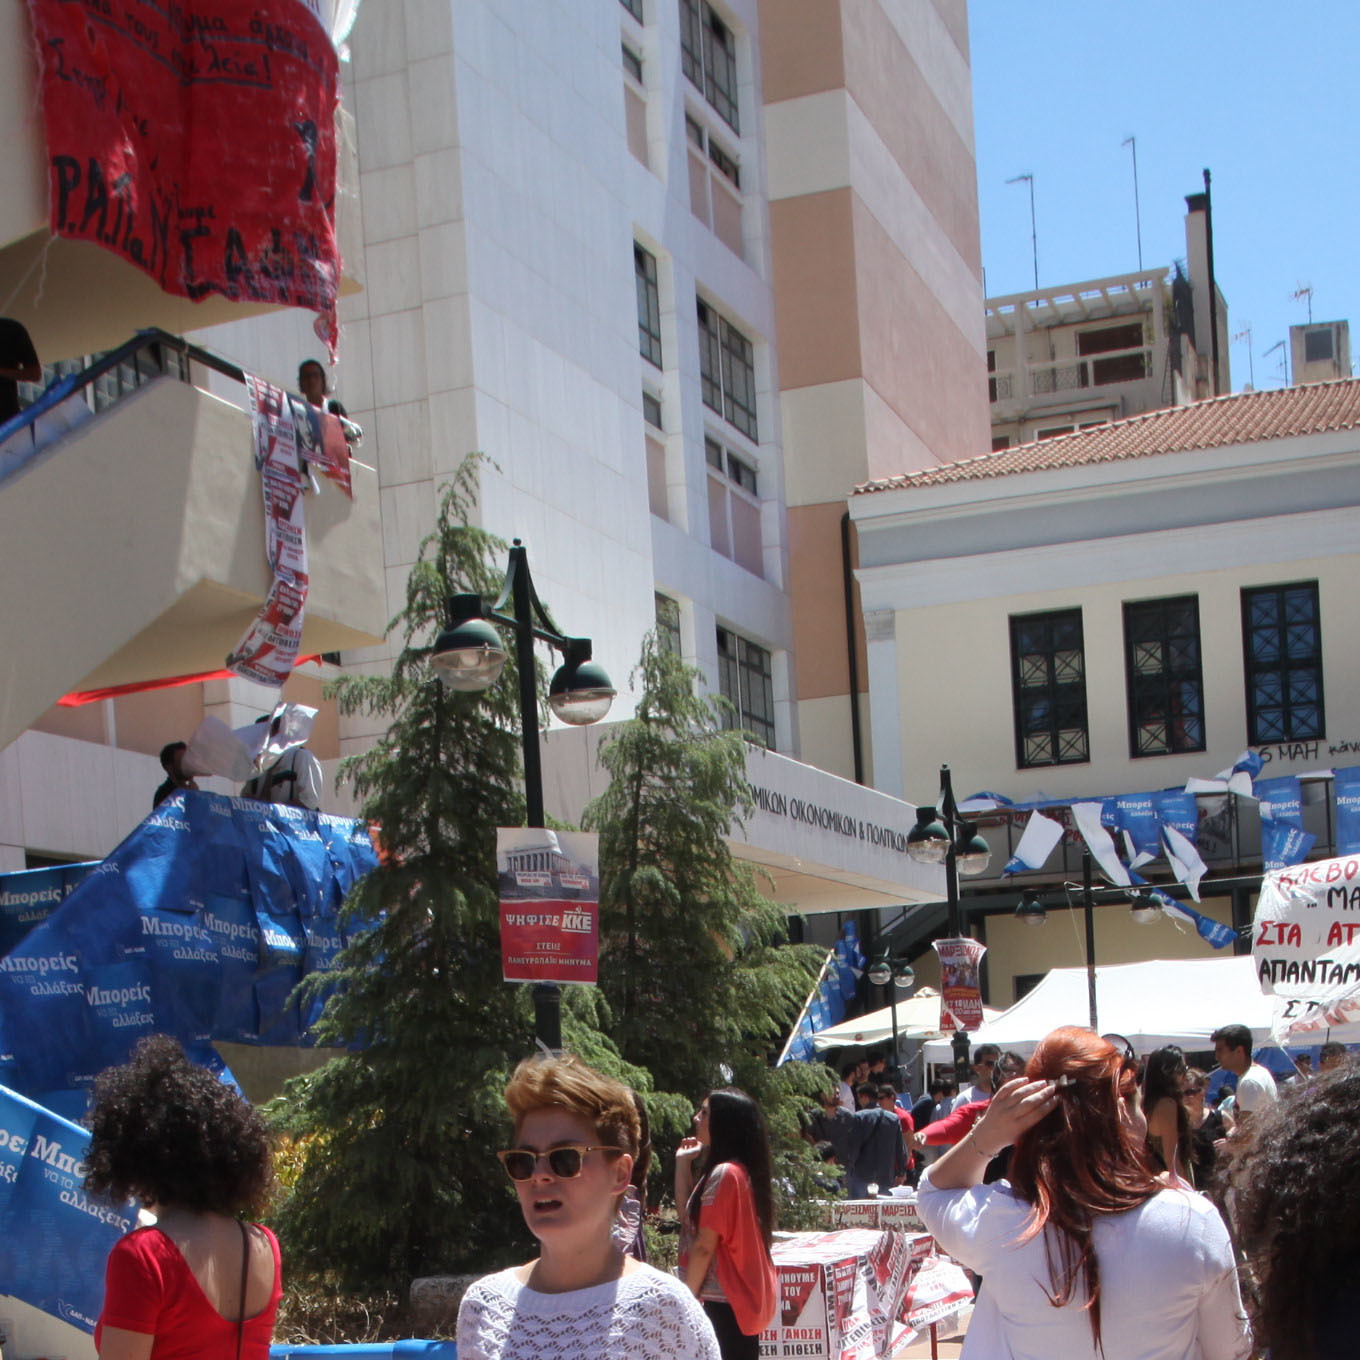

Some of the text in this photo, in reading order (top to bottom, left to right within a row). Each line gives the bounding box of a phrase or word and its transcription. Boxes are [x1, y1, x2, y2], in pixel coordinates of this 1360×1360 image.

[748, 784, 788, 817] ΟΜΙΚΩΝ
[790, 798, 857, 839] ΟΙΚΟΝΟΜΙΚΩΝ
[505, 913, 593, 931] ΨΗΦΙΣΕ ΚΚΕ
[1255, 920, 1302, 949] ΣΤΑ
[783, 1342, 823, 1356] ΠΙΘΕΣΗ
